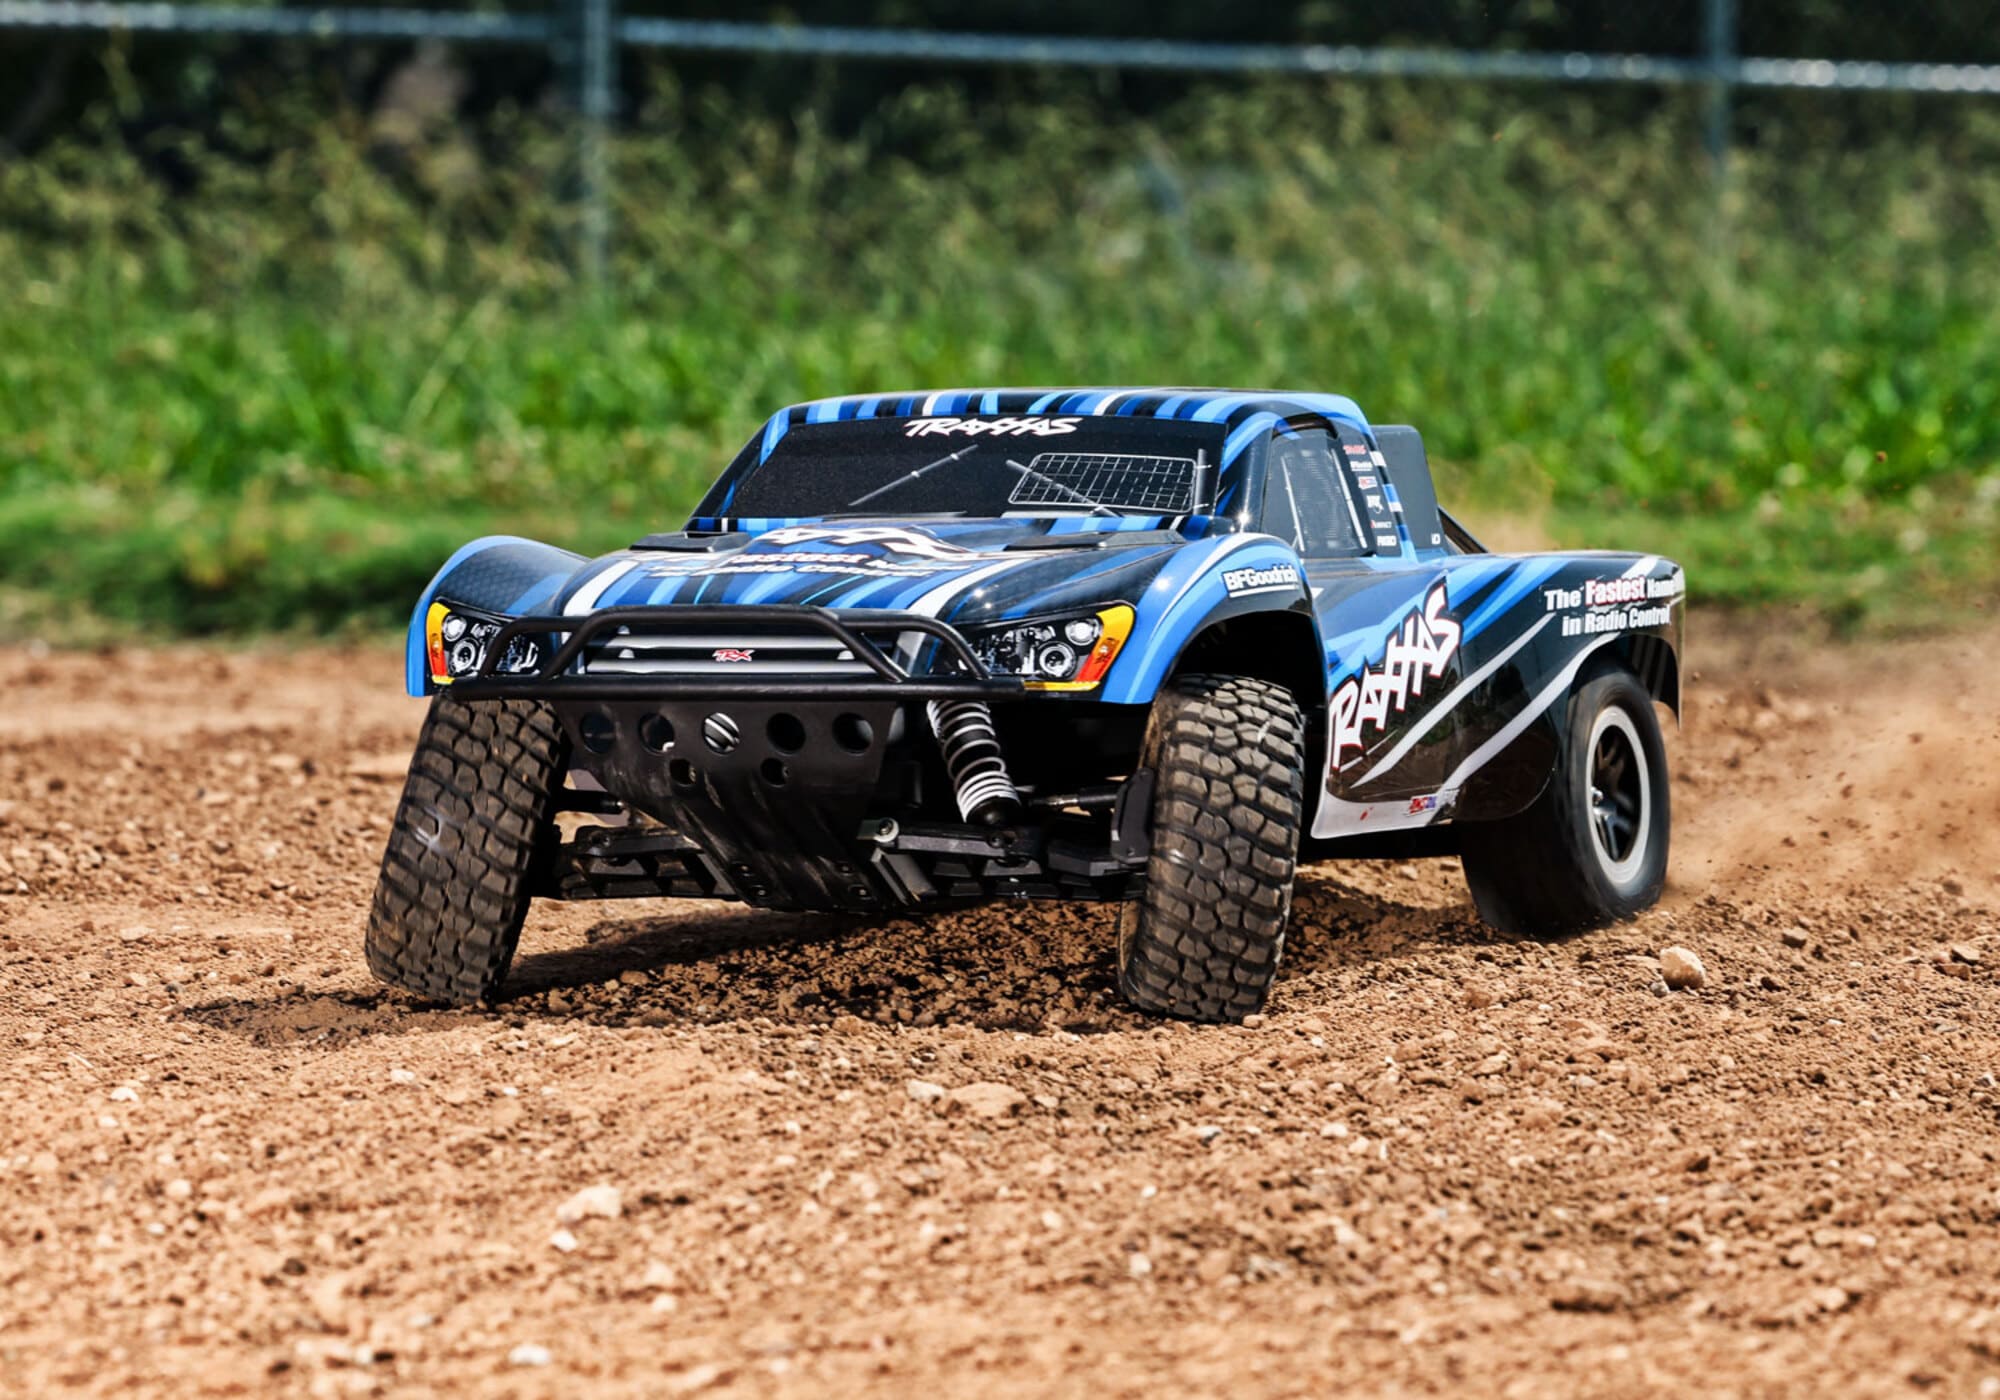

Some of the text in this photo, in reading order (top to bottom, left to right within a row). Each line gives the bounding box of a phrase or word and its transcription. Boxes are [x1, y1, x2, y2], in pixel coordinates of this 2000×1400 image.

[904, 417, 1083, 437] TRAXXAS
[1223, 565, 1298, 591] BFGoodrich
[1544, 588, 1582, 611] The
[1585, 577, 1647, 606] Fastest
[1562, 605, 1671, 637] in Radio Control
